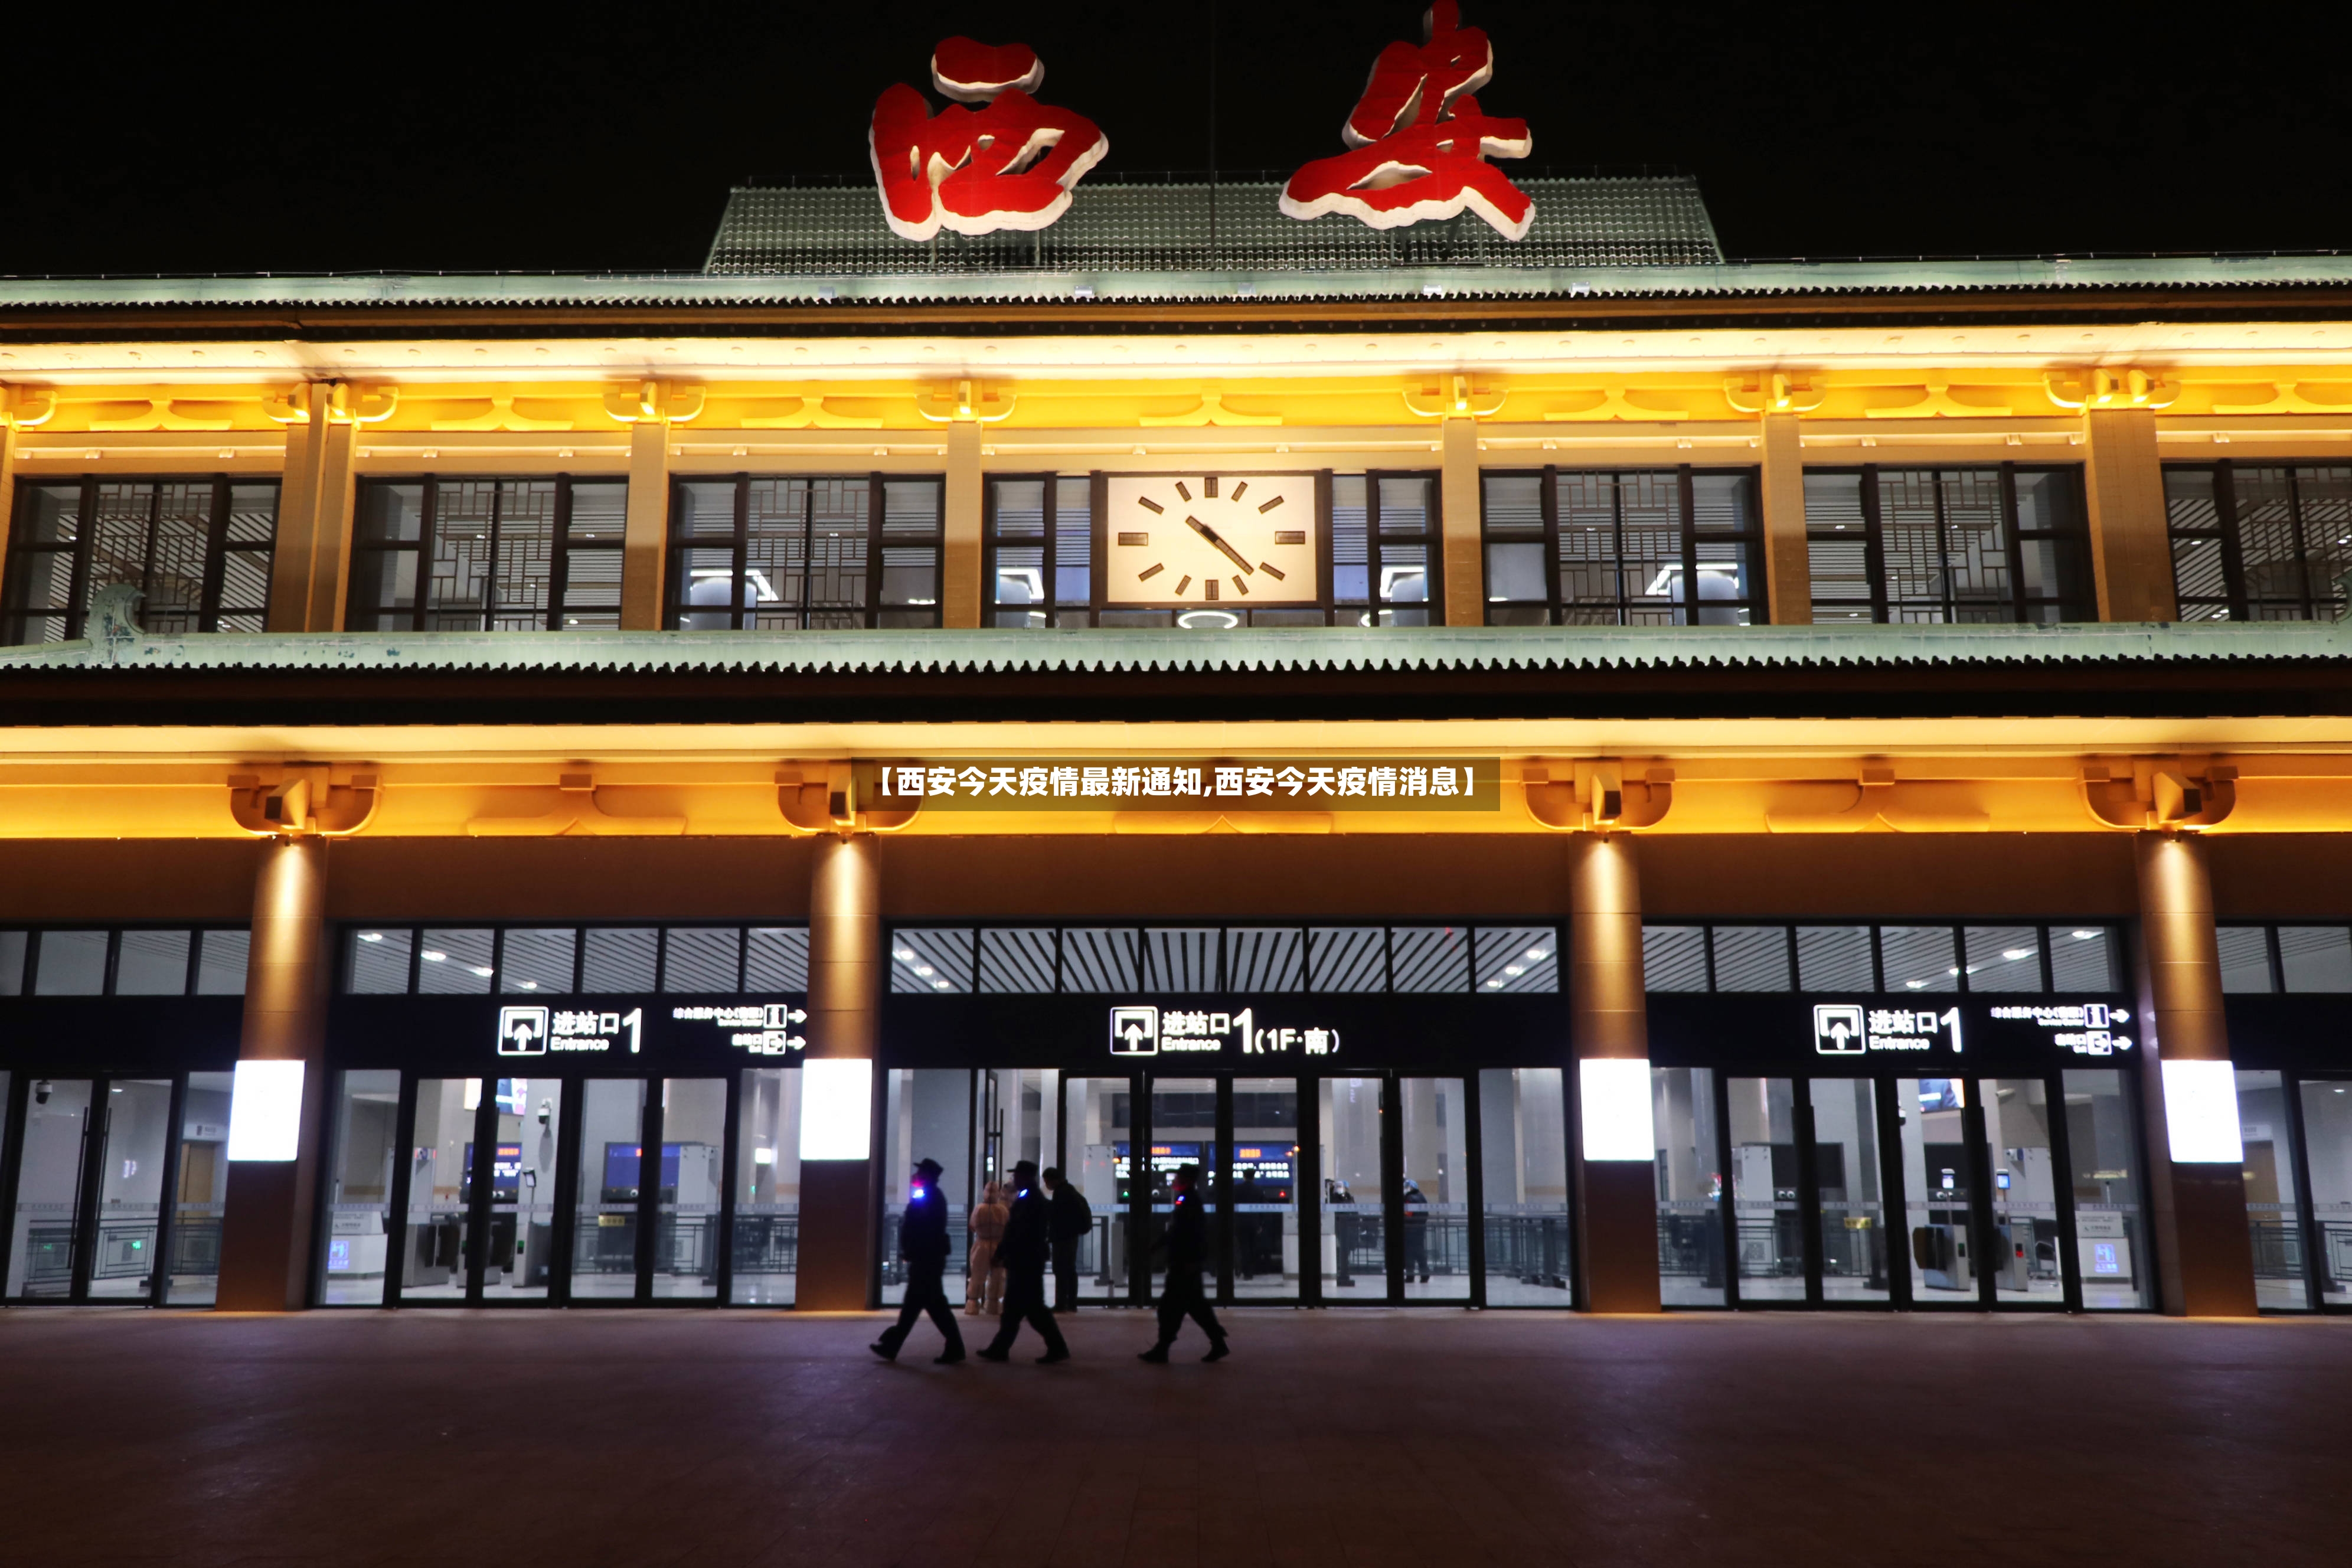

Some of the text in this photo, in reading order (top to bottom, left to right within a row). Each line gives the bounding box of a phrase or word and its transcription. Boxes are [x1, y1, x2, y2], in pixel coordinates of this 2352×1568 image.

[868, 0, 1537, 243] 西安
[552, 1011, 619, 1035] 进站口
[1162, 1011, 1229, 1035] 进站口
[1868, 1010, 1938, 1034] 进站口
[551, 1037, 609, 1050] Entrance
[1161, 1037, 1221, 1051] Entrance
[1869, 1035, 1929, 1050] Entrance
